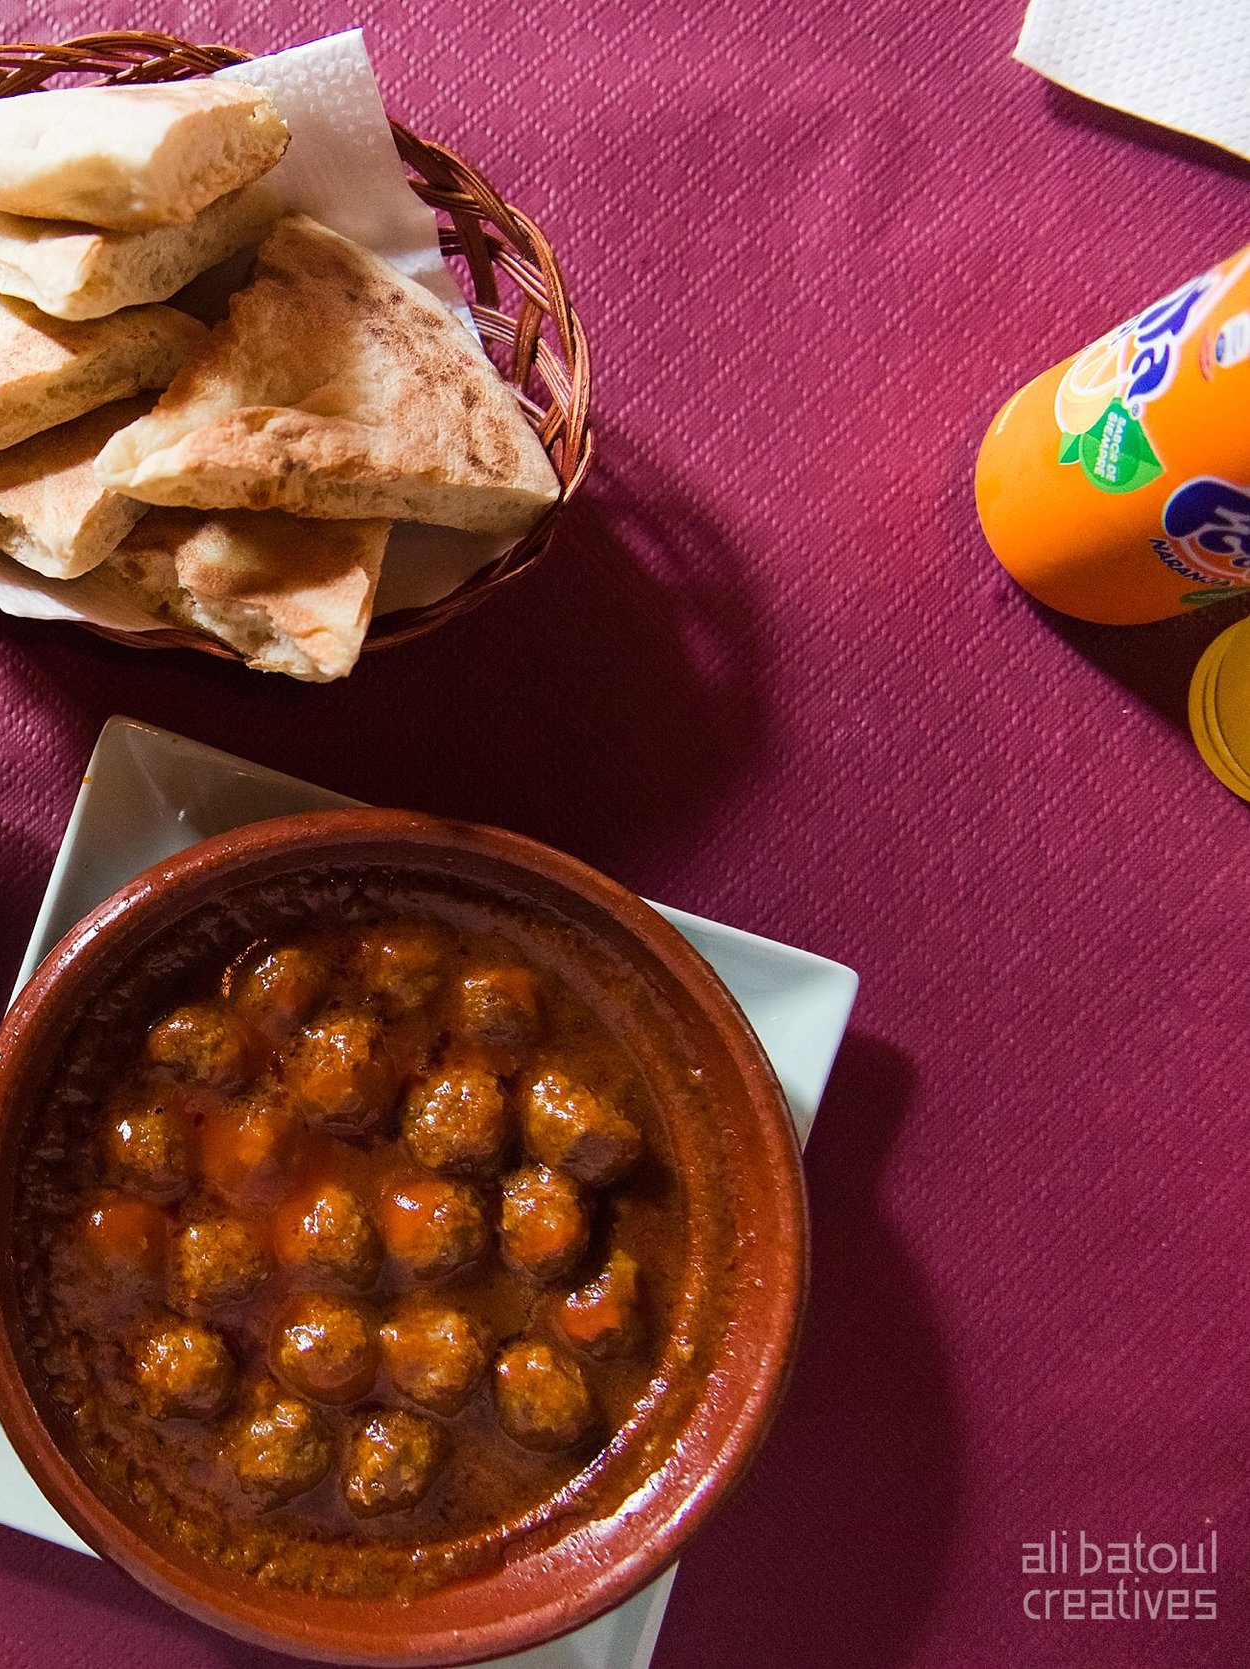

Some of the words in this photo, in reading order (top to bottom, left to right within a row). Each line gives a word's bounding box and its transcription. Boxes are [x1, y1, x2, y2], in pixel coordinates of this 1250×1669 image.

[1094, 411, 1118, 478] SIEMPRE
[1108, 416, 1126, 463] SABOR
[1105, 462, 1117, 483] DE
